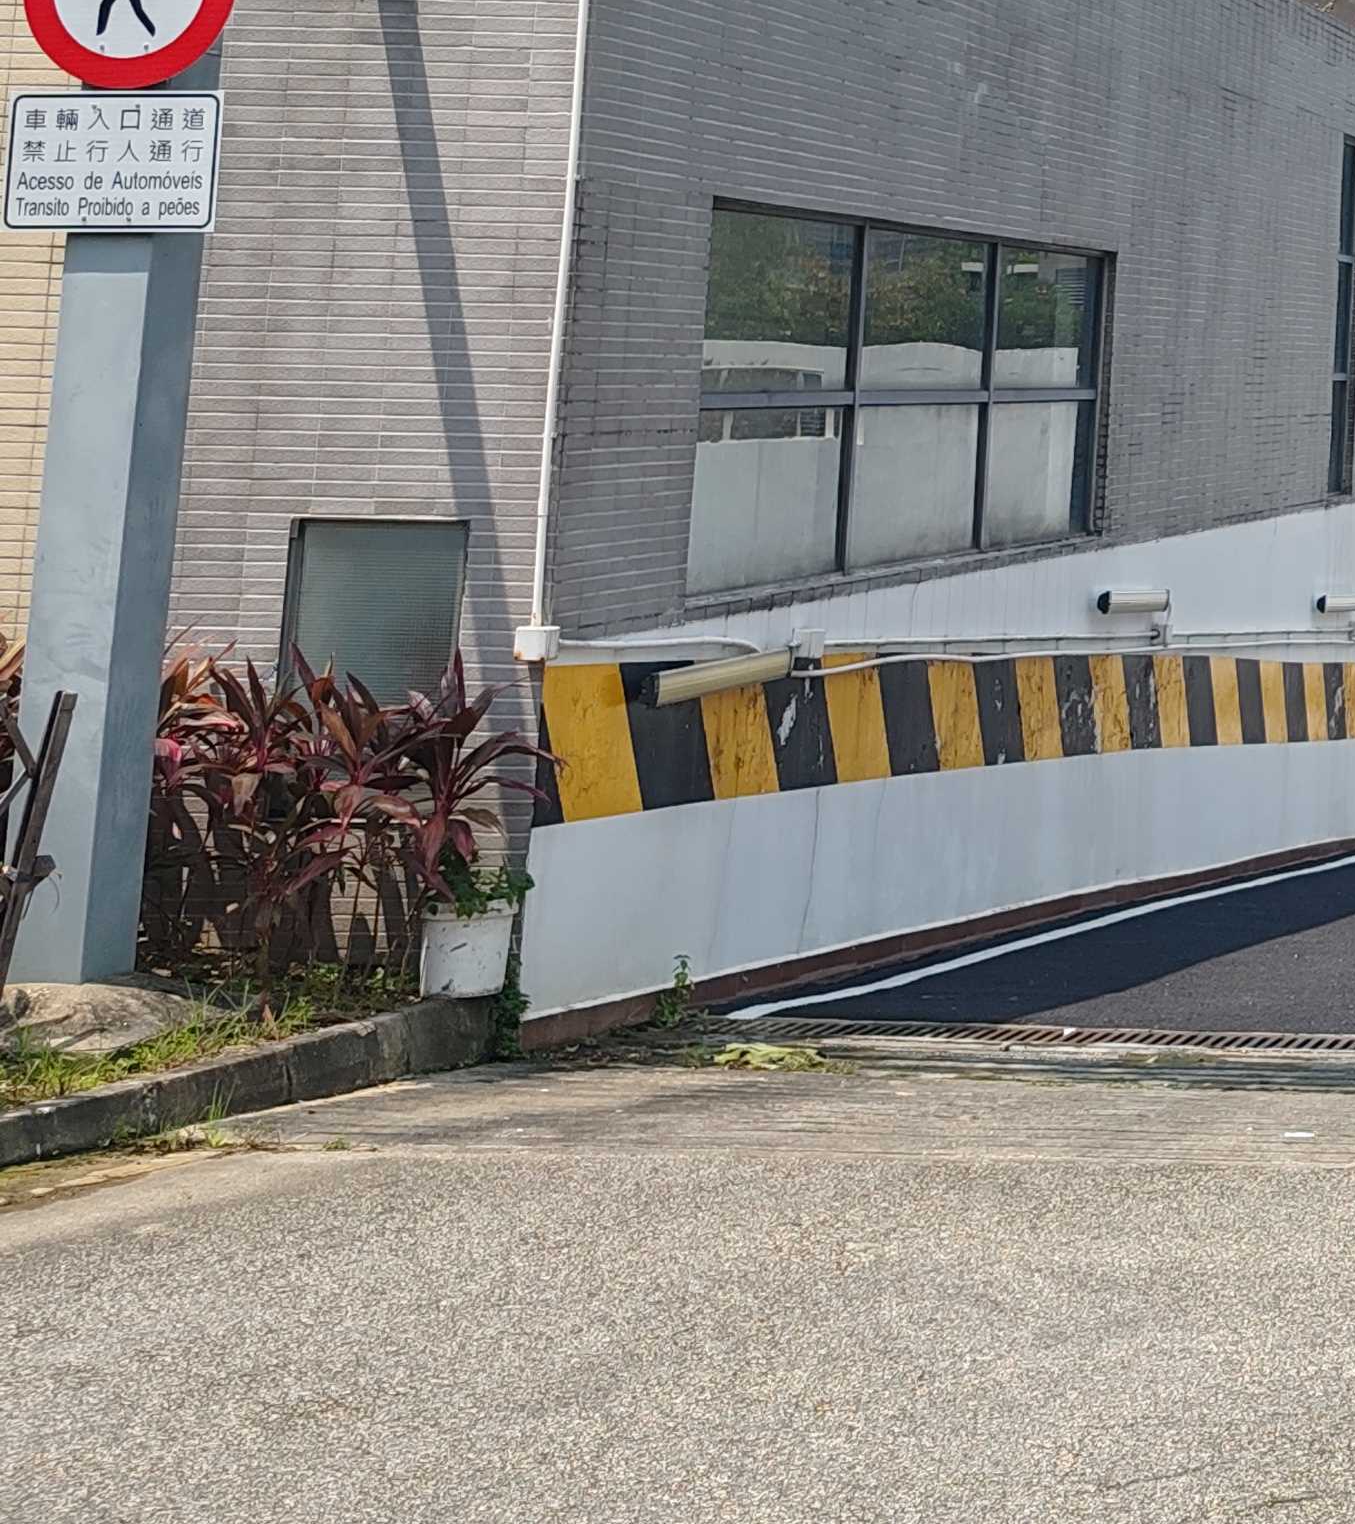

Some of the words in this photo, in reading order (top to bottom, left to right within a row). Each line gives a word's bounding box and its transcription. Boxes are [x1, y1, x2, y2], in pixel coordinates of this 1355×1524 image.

[23, 108, 206, 132] 車輛入口通道
[22, 140, 204, 163] 禁止行人通行
[16, 171, 74, 190] Acesso
[84, 171, 103, 190] de
[112, 170, 203, 190] Automóveis
[78, 197, 133, 217] Proibido
[141, 202, 150, 216] a
